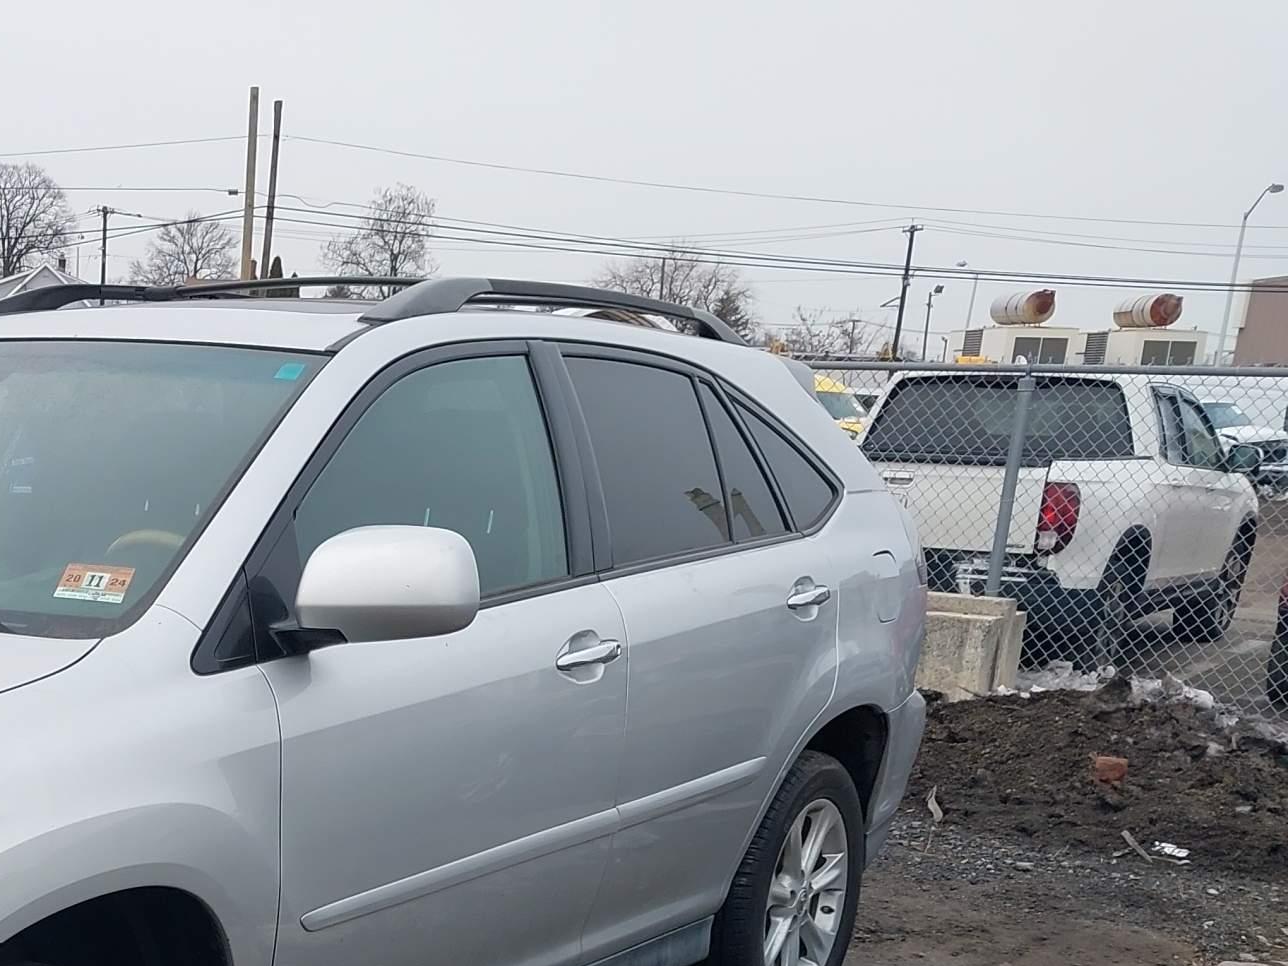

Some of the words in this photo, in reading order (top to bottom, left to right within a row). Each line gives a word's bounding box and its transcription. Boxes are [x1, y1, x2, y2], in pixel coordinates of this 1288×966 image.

[65, 574, 82, 583] 20
[85, 574, 104, 588] 11
[109, 578, 127, 587] 24
